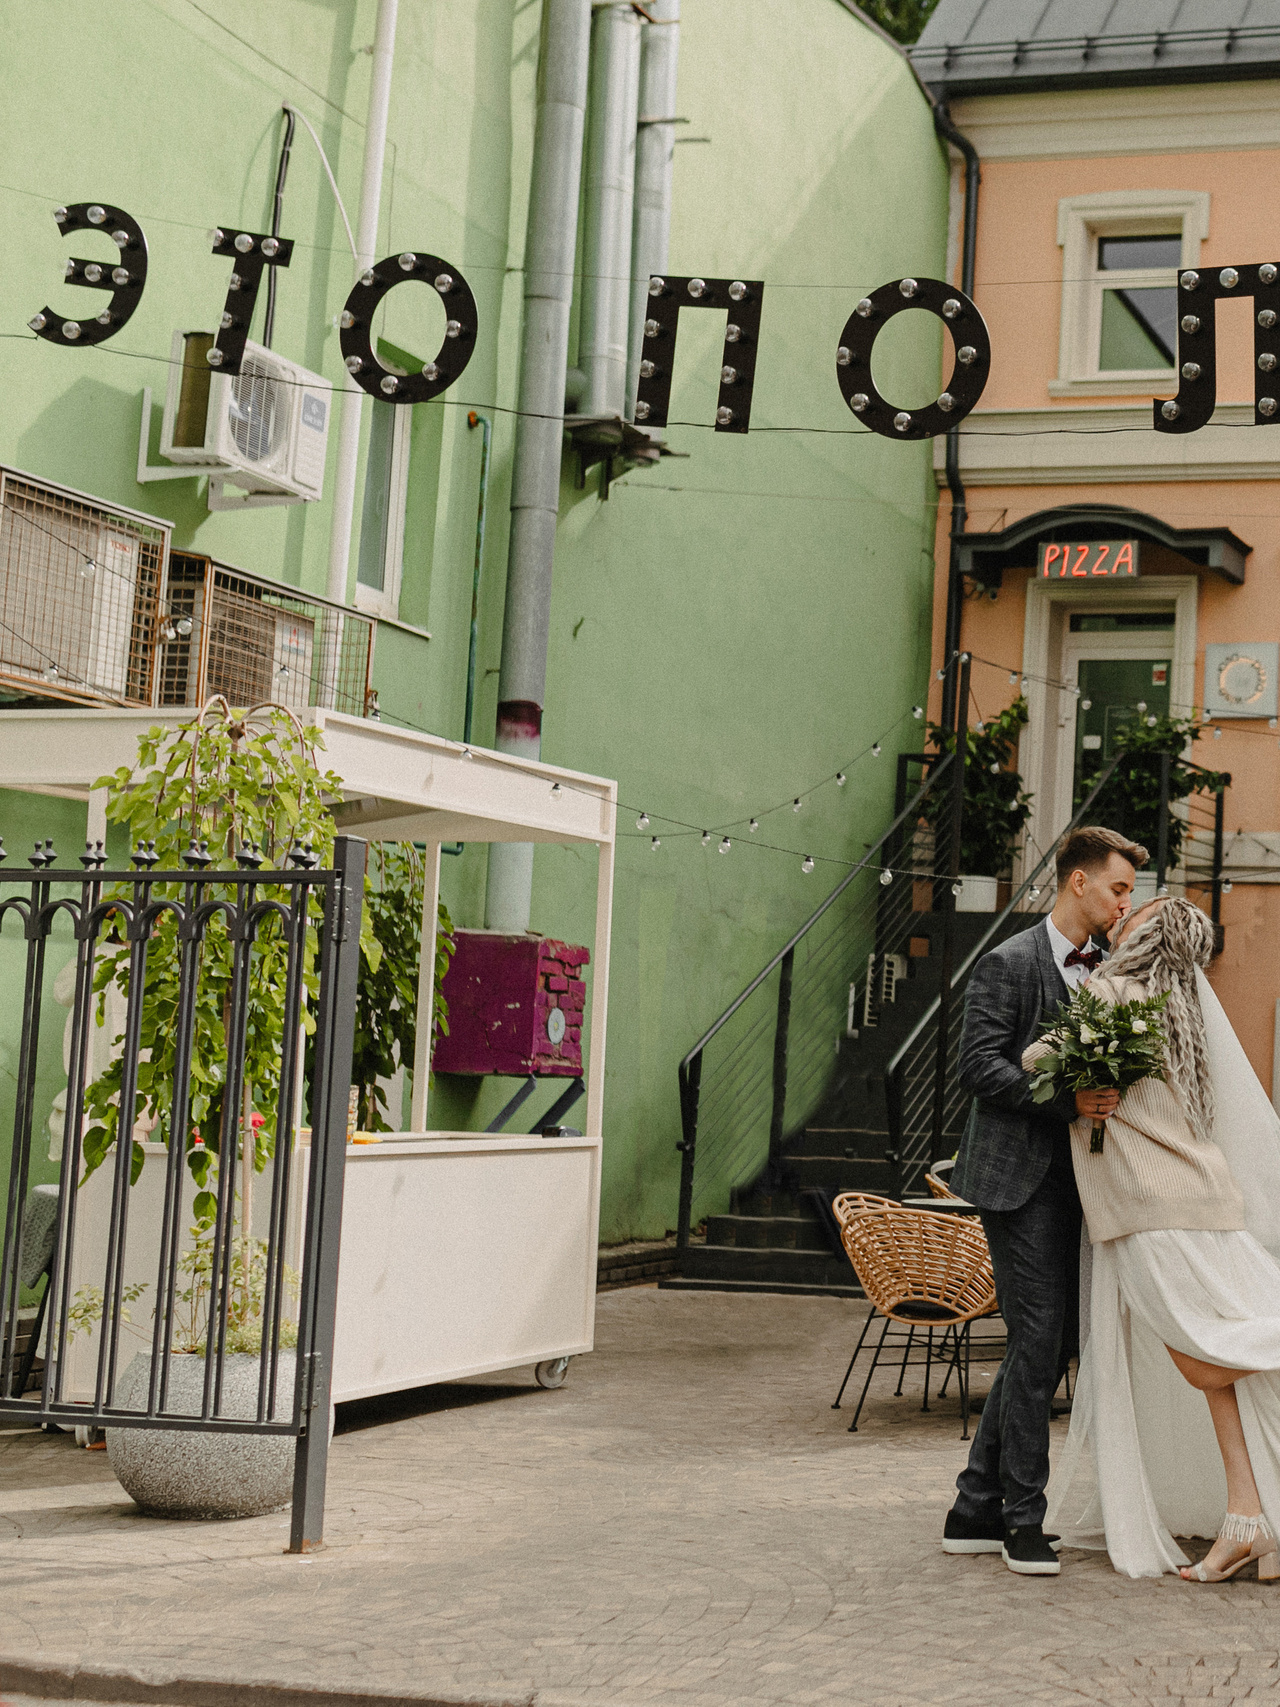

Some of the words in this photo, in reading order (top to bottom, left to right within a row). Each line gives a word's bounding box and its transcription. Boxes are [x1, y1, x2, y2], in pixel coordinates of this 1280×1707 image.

[27, 202, 478, 404] ЭТО
[635, 275, 991, 441] ПО
[1043, 543, 1133, 577] PIZZA
